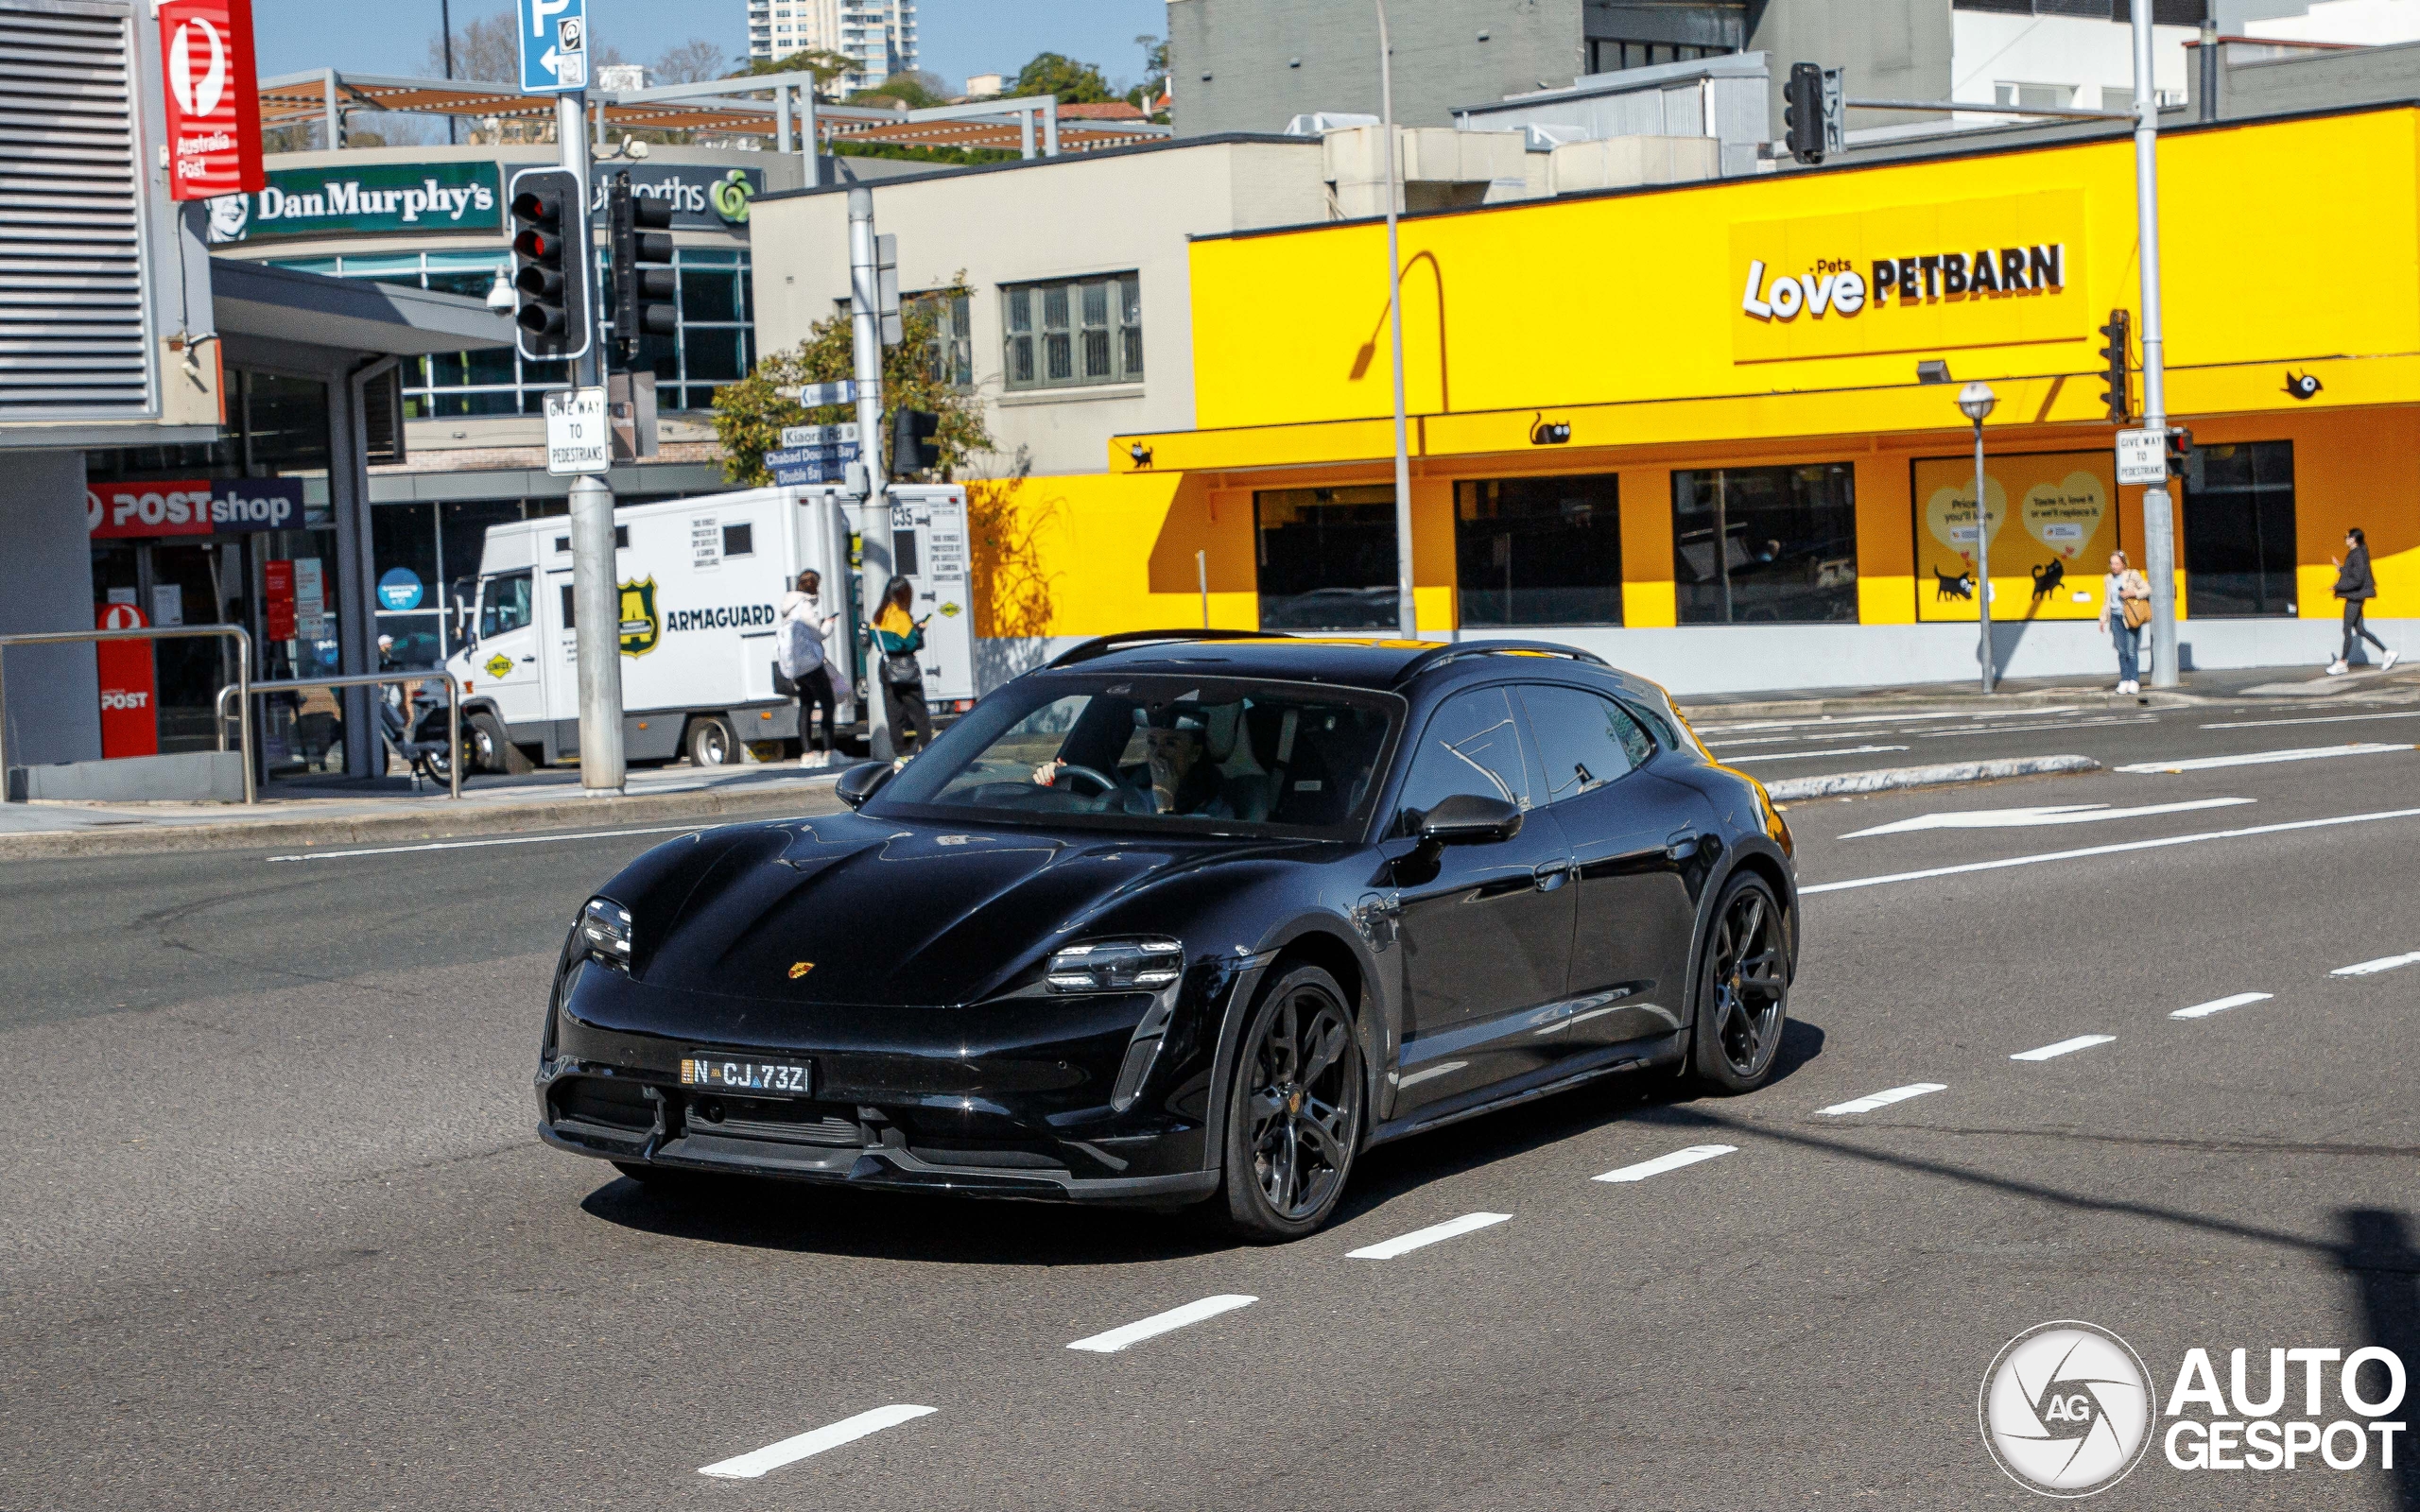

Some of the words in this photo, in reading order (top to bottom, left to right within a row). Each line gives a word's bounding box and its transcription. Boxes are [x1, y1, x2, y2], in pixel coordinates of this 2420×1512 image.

[177, 129, 230, 157] Australia
[177, 157, 206, 180] Post
[1817, 258, 1852, 274] Pets
[1742, 258, 1864, 318] Love
[1872, 243, 2064, 302] PETBARN
[578, 401, 600, 415] WAY
[569, 423, 582, 438] TO
[786, 428, 824, 443] Kiaora
[2143, 437, 2162, 446] WAY
[552, 446, 602, 463] PEDESTRIANS
[2137, 451, 2148, 461] TO
[666, 604, 775, 631] ARMAGUARD
[101, 692, 147, 710] POST
